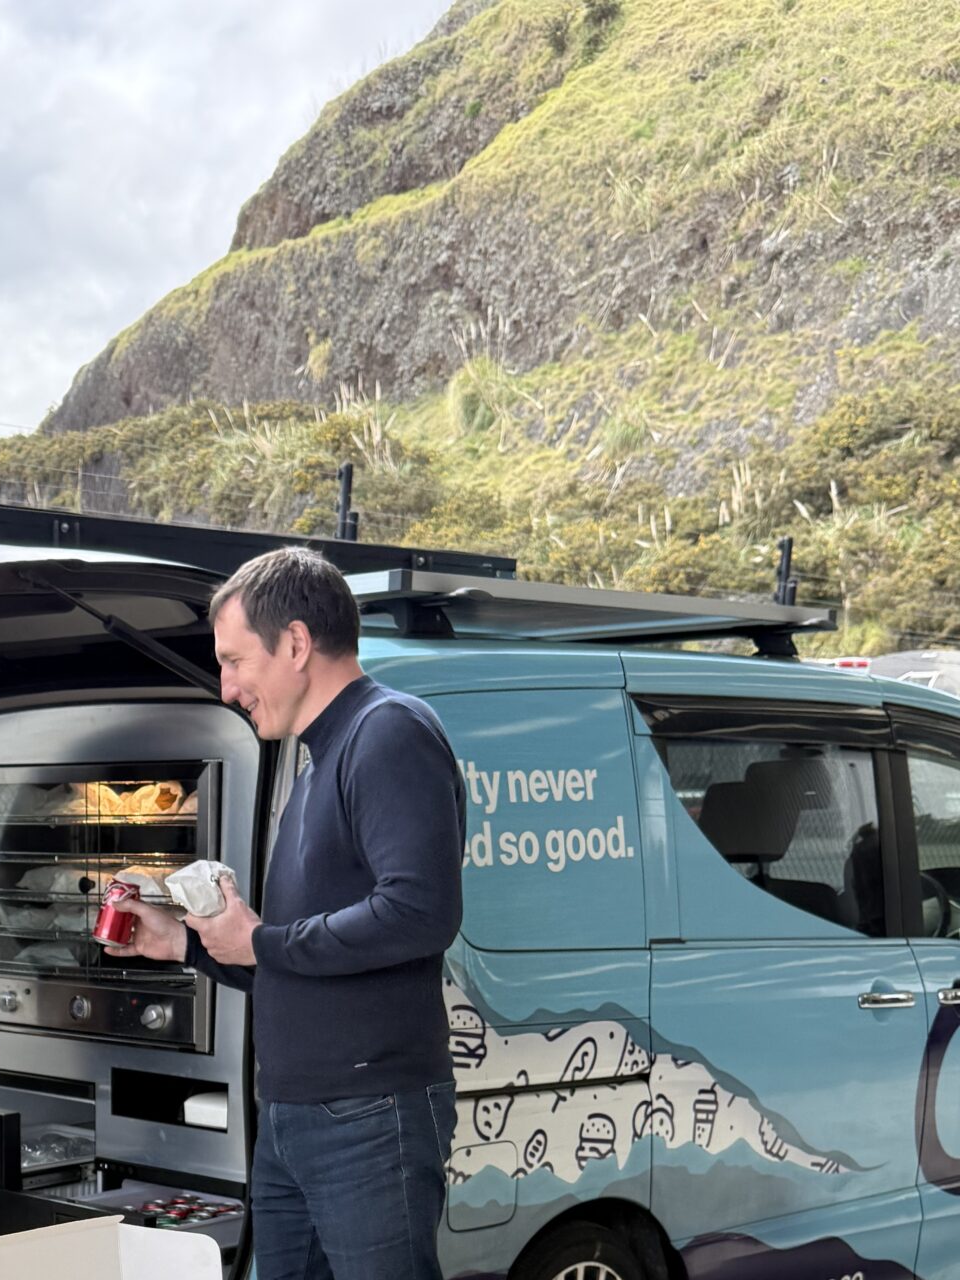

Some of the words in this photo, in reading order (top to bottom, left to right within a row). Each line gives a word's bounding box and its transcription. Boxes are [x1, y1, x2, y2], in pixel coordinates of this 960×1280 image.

[457, 759, 500, 814] ty
[507, 768, 597, 803] never
[499, 831, 539, 865] so
[545, 815, 634, 872] good.
